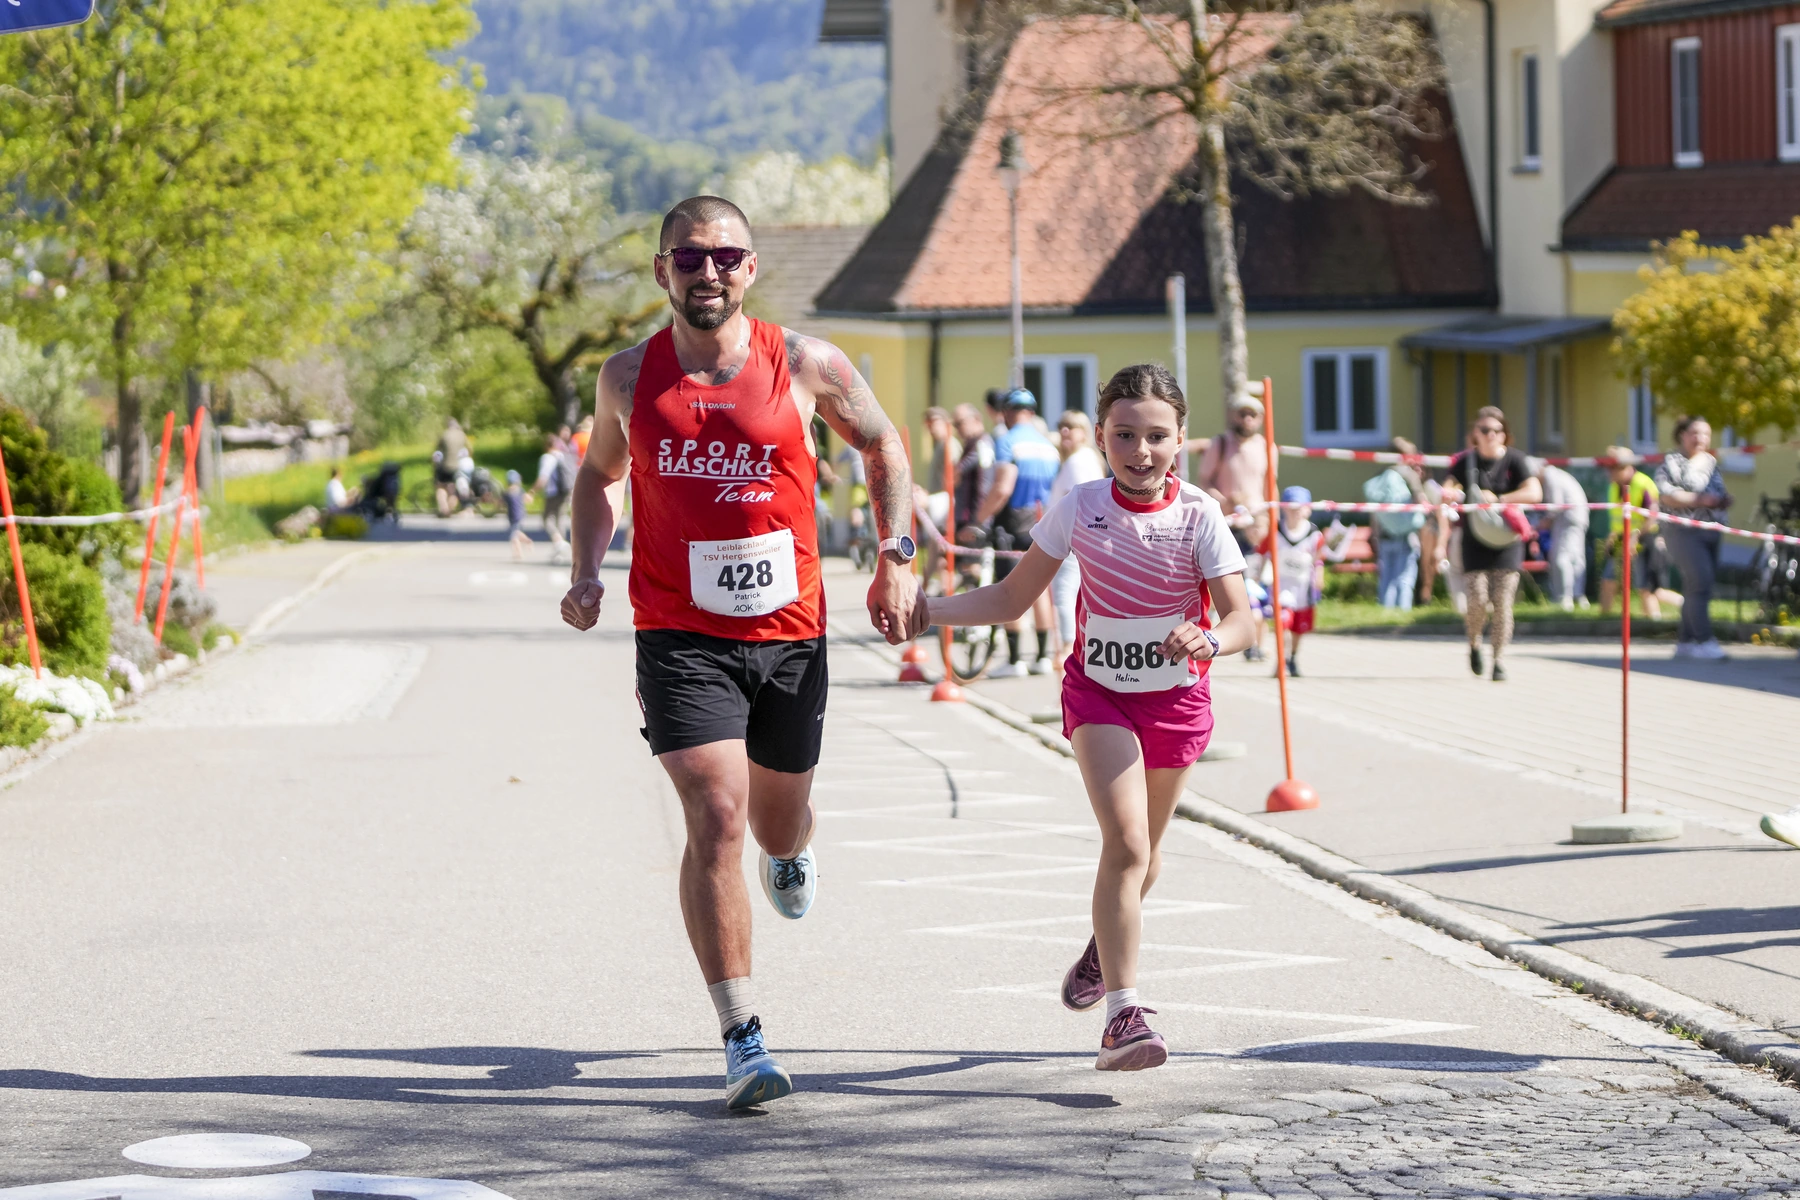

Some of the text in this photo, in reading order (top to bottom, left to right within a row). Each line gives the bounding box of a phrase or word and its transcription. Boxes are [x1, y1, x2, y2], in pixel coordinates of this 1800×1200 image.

[692, 401, 736, 409] SALOMON
[658, 439, 777, 461] SPORT
[658, 456, 772, 476] HASCHKO
[714, 482, 775, 503] Team
[1087, 522, 1108, 530] erima
[716, 539, 767, 552] Leiblachlauf
[722, 545, 781, 561] Hergensweiler
[717, 559, 773, 592] 428
[734, 592, 761, 601] Patrick
[733, 604, 754, 613] AOK
[1087, 637, 1179, 671] 2086
